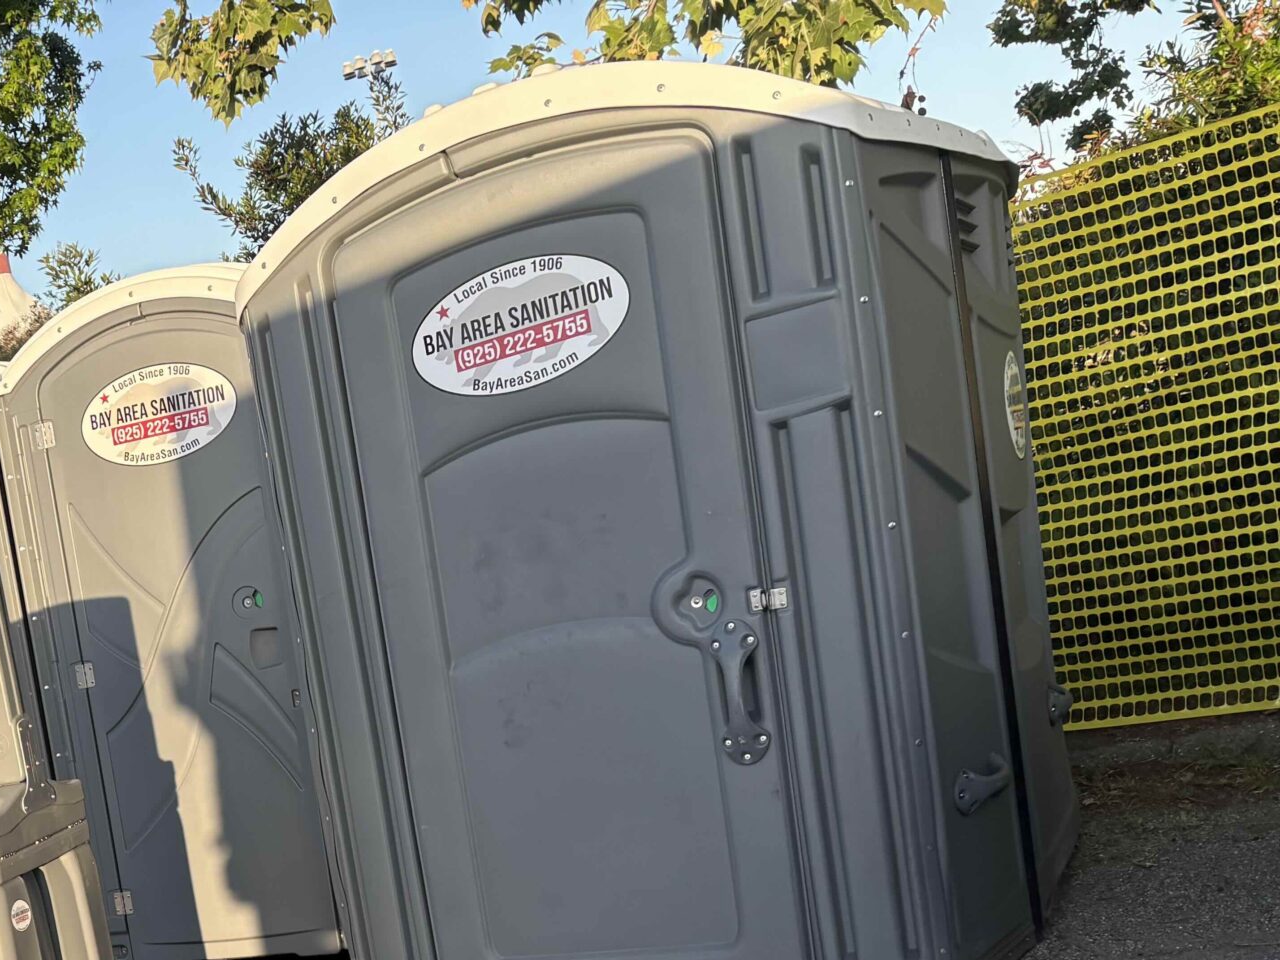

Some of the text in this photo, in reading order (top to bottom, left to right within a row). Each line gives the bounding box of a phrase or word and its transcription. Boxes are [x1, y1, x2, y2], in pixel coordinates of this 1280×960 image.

[453, 257, 562, 303] Local Since 1906
[423, 276, 613, 356] BAY AREA SANITATION
[458, 314, 588, 370] (925) 222-5755
[112, 366, 190, 393] Local Since 1906
[473, 351, 579, 394] BayAreaSan.com
[90, 384, 225, 430] BAY AREA SANITATION
[114, 410, 207, 443] (925) 222-5755
[124, 438, 200, 463] BayAreaSan.com
